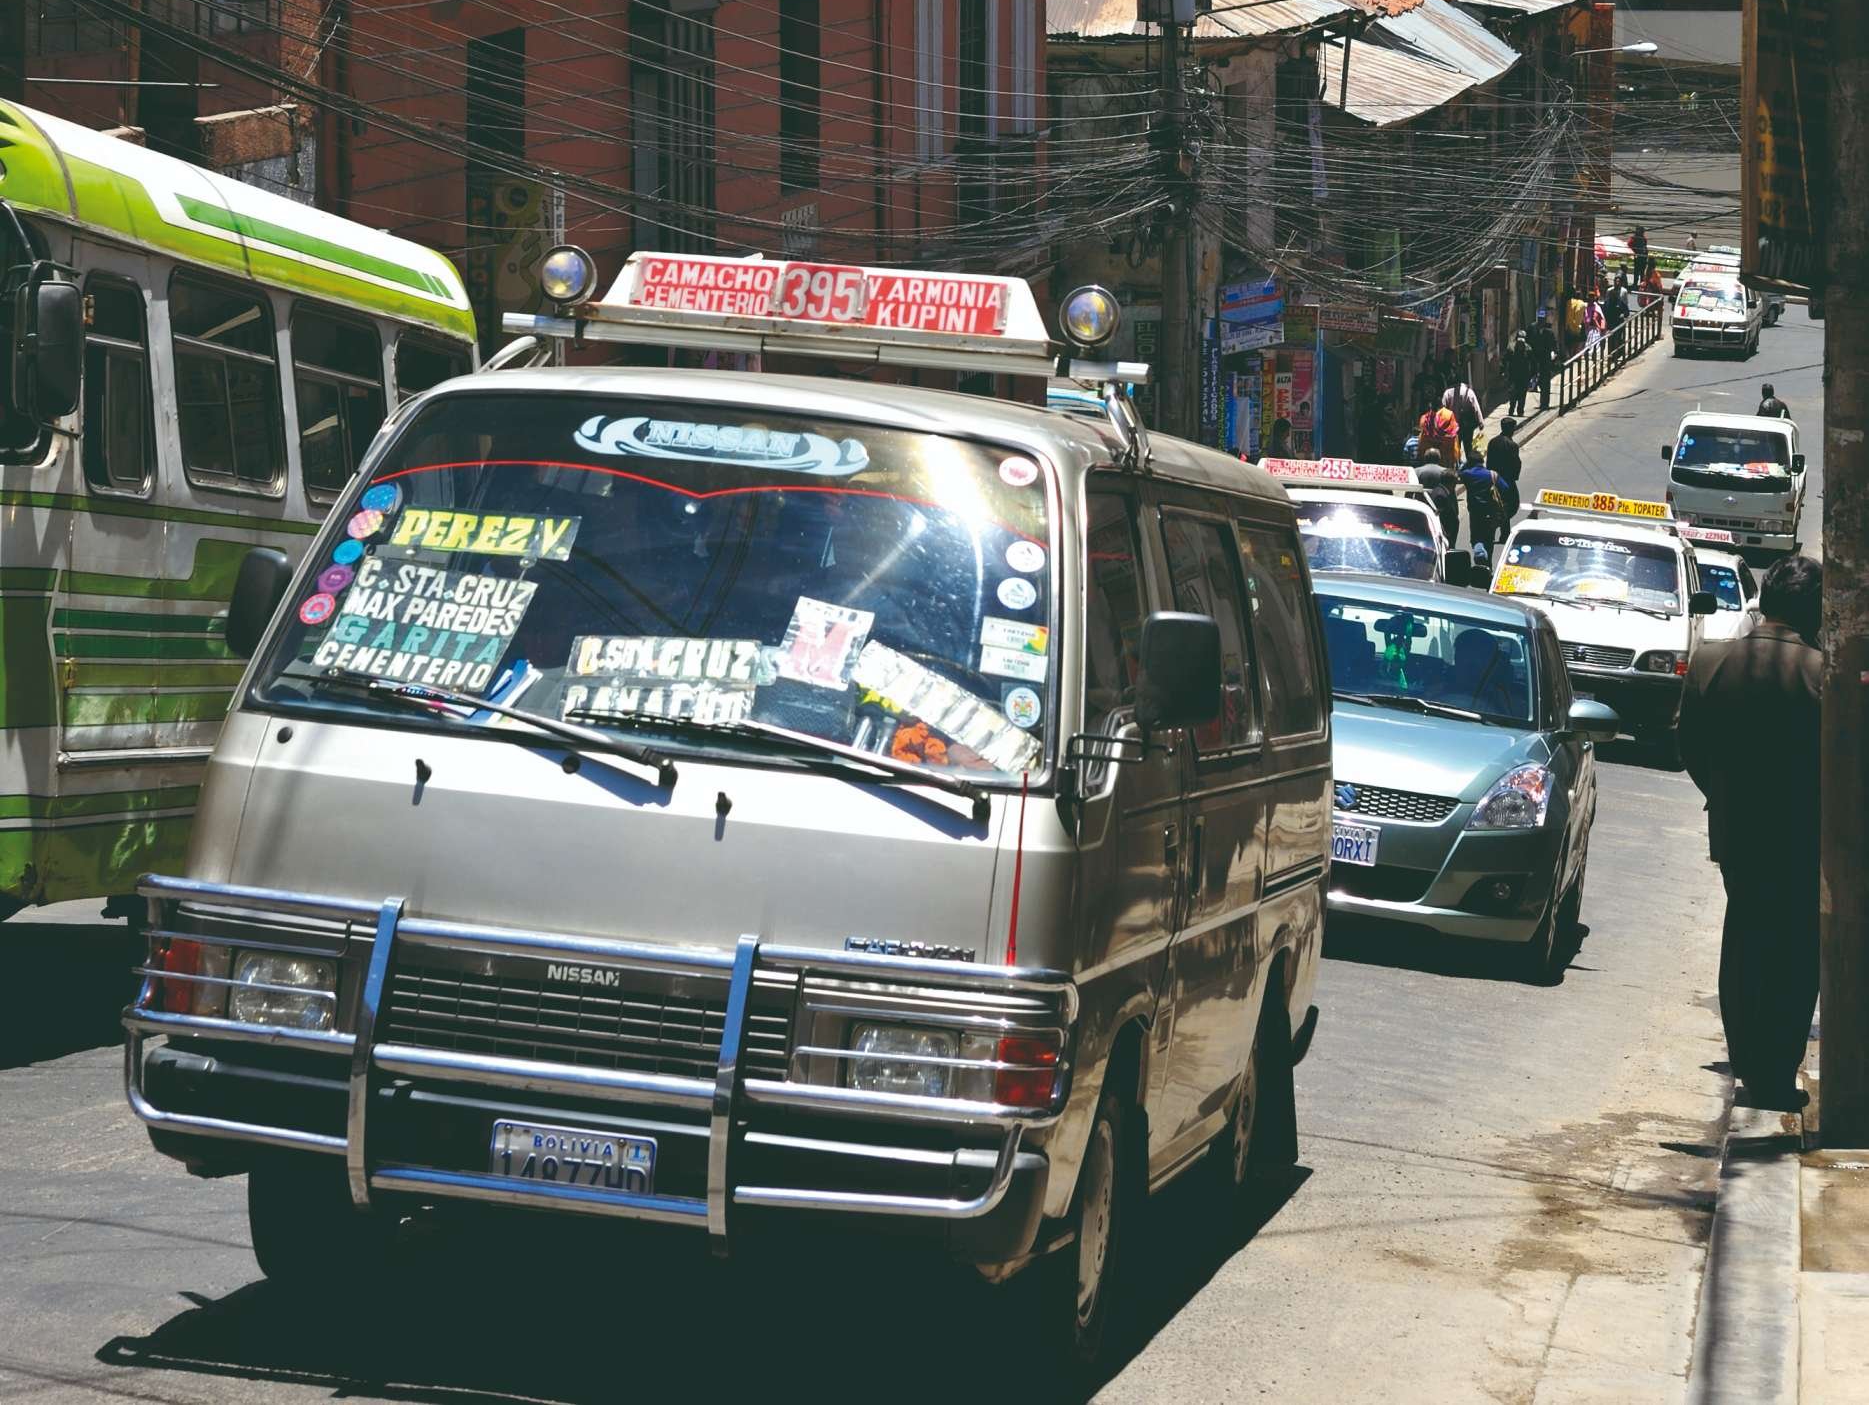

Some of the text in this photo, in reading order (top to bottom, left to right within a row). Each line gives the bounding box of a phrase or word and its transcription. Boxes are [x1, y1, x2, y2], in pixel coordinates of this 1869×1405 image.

[645, 261, 774, 291] CAMACHO
[640, 285, 769, 316] CEMENTERIO
[782, 268, 863, 321] 395
[876, 302, 978, 333] KUPINI
[643, 420, 801, 458] NISSAN
[1322, 459, 1349, 479] 255
[1542, 492, 1590, 509] CEMENTERIO
[1592, 494, 1617, 512] 385
[1633, 503, 1665, 517] TOPATER
[392, 510, 571, 556] PEREZ V.
[341, 587, 521, 636] MAX PAREDES
[335, 615, 500, 664] GARITA
[314, 641, 493, 689] CEMENTERIO
[547, 963, 621, 987] NISSAN
[533, 1134, 613, 1157] BOLIVIA
